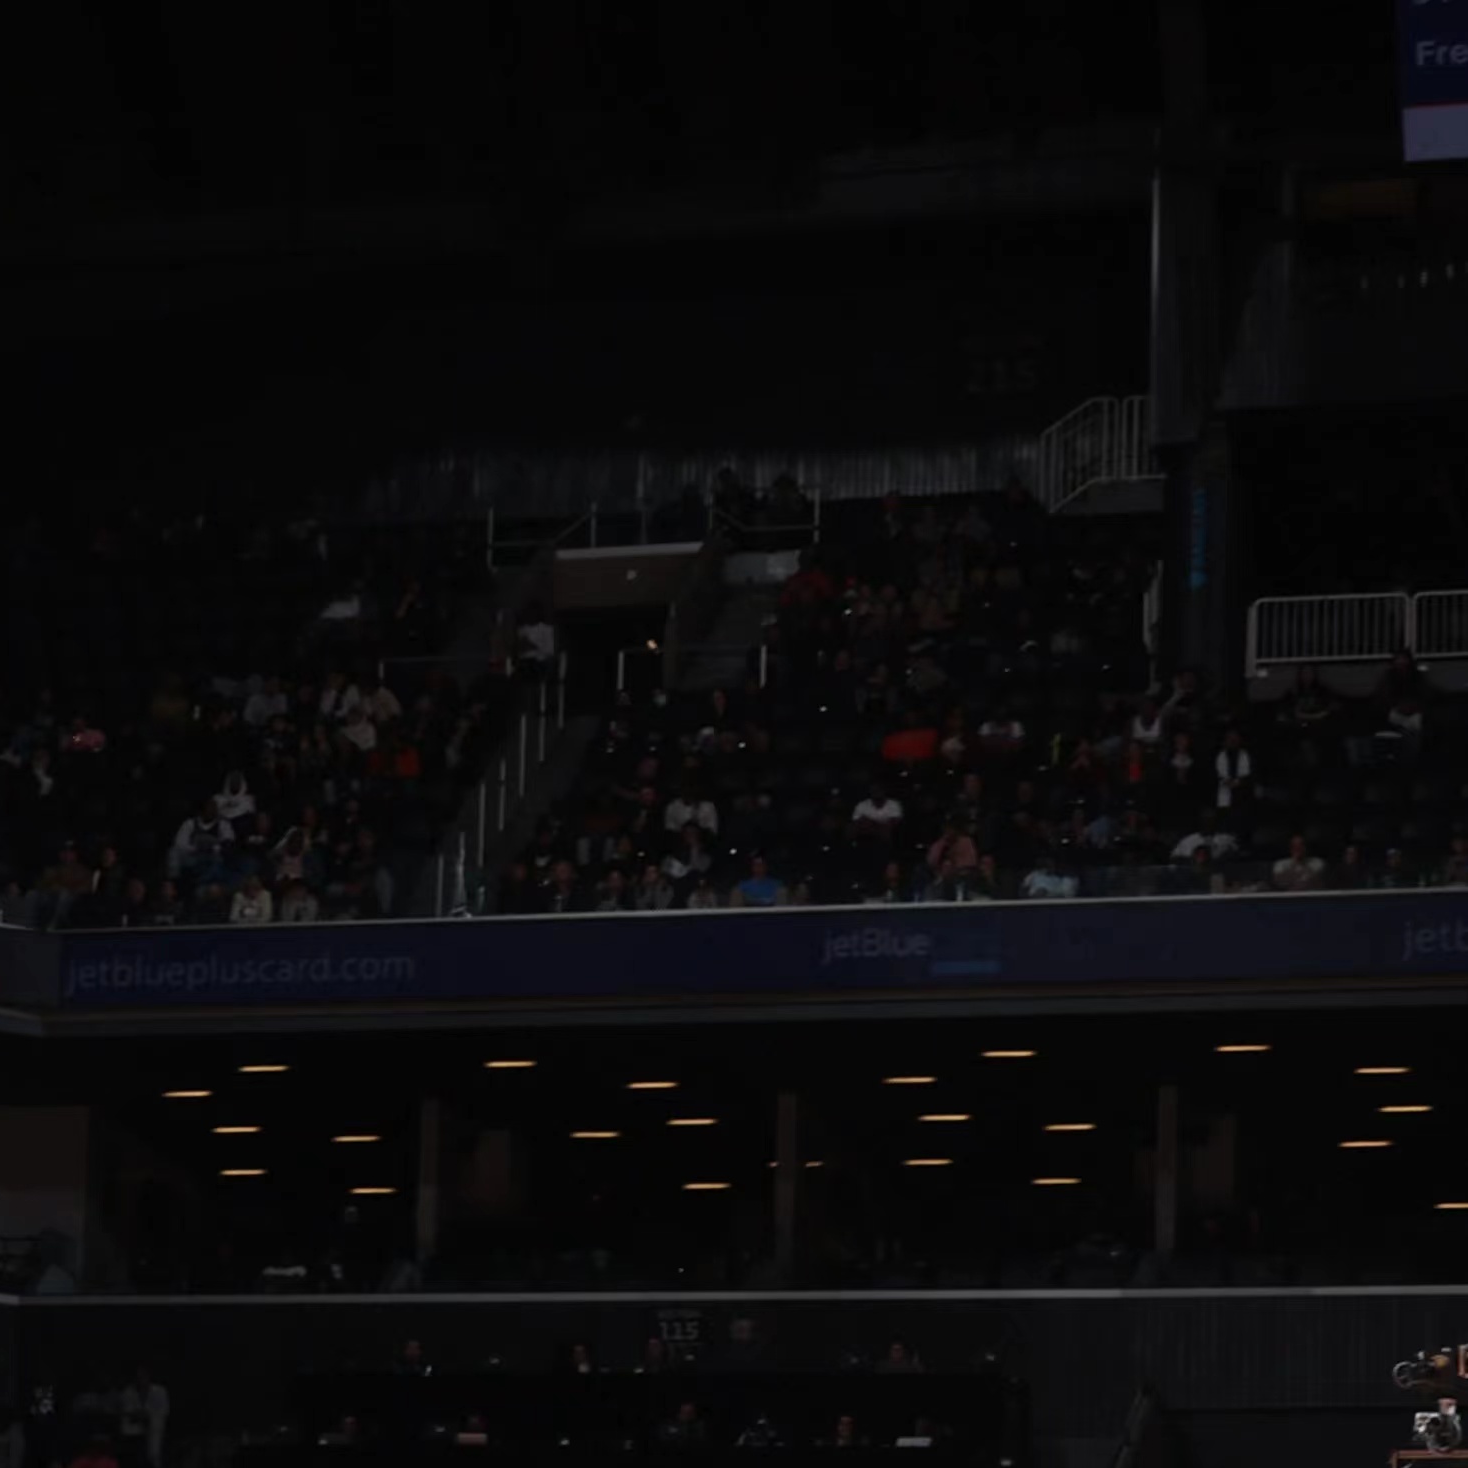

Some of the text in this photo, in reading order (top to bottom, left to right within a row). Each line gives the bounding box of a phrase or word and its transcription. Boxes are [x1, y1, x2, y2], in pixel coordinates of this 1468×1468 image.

[822, 927, 932, 966] jetBlue
[68, 950, 415, 994] jetbluepluscard.com
[659, 1320, 700, 1341] 115
